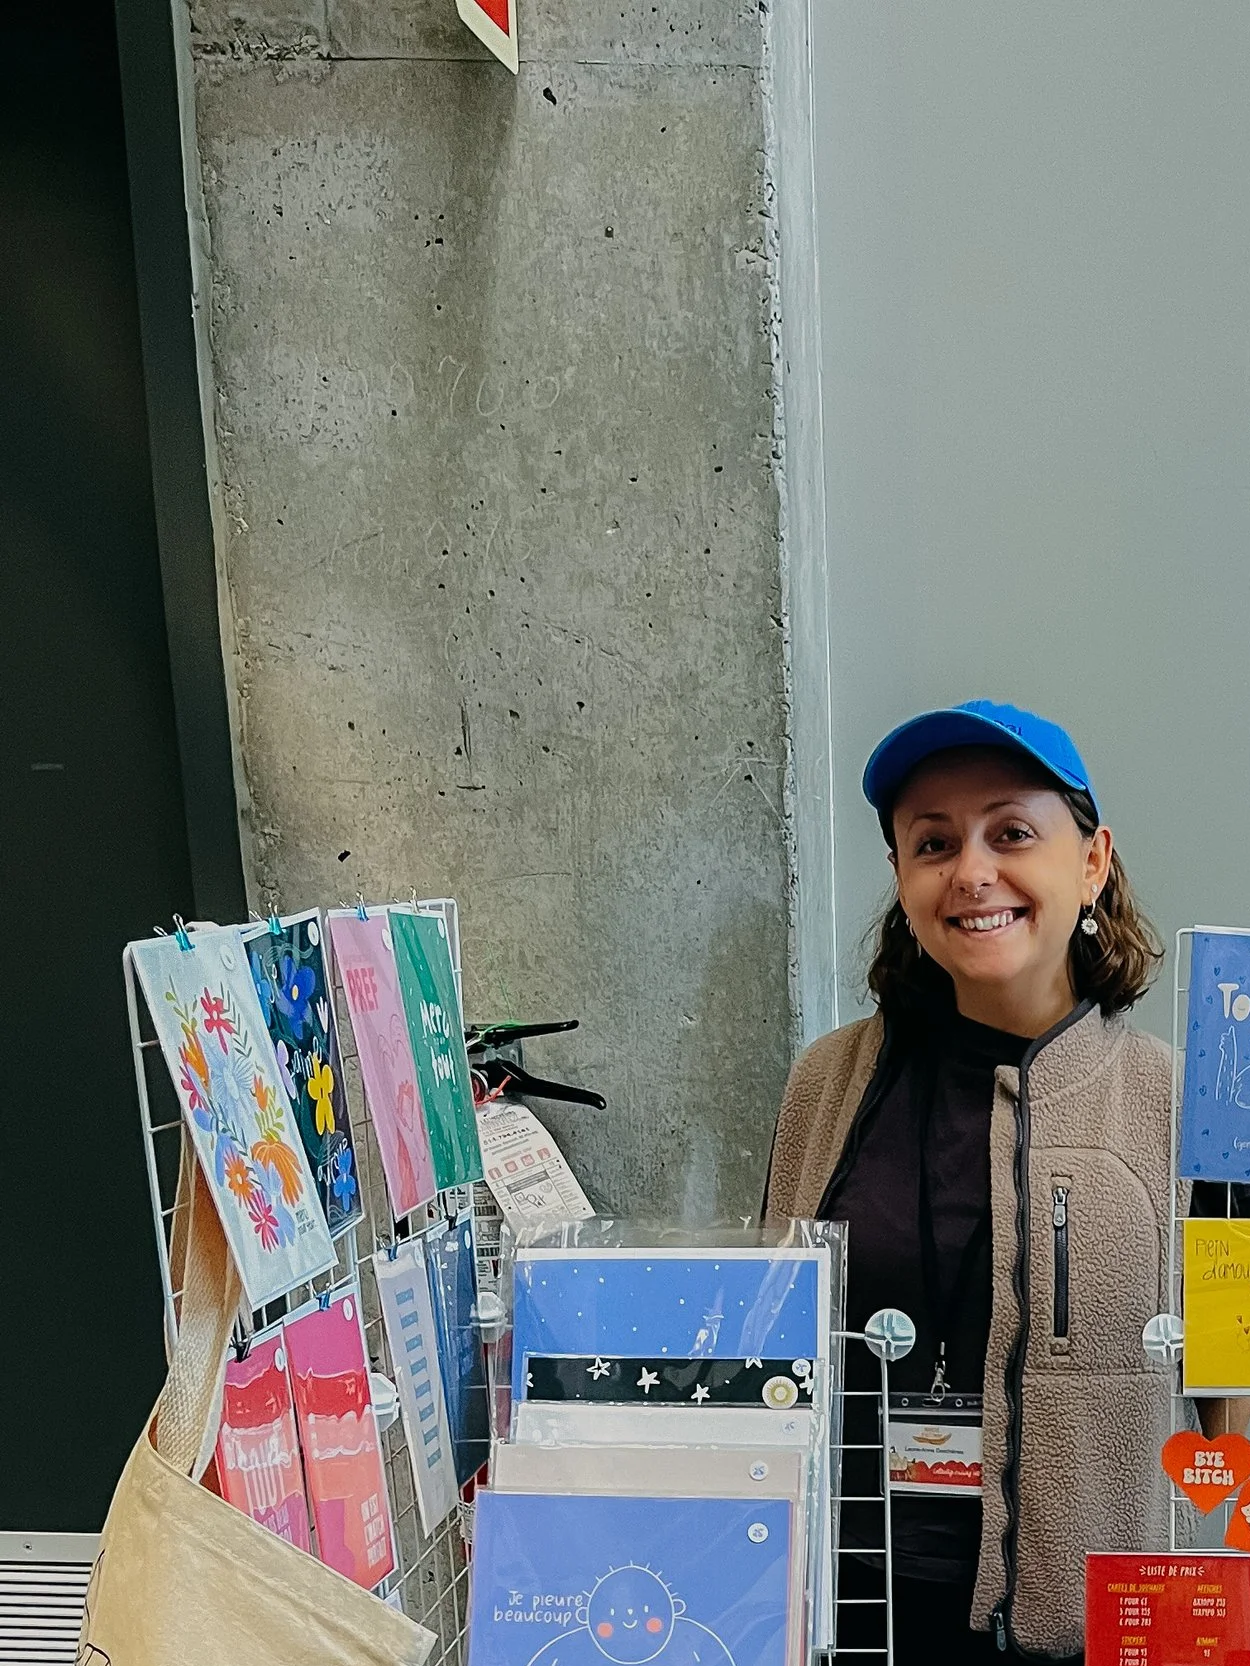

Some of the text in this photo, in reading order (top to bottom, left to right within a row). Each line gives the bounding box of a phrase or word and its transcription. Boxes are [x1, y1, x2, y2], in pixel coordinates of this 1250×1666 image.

[1194, 1451, 1225, 1467] BYE
[1183, 1468, 1235, 1486] BITCH
[1147, 1565, 1197, 1577] LISTE DE PRIX
[509, 1590, 583, 1611] Je pleure
[1124, 1597, 1139, 1605] POUR
[494, 1605, 572, 1627] beaucoup
[1124, 1608, 1139, 1616] POUR
[1124, 1618, 1139, 1626] POUR
[1124, 1648, 1139, 1657] POUR
[1124, 1658, 1139, 1666] POUR
